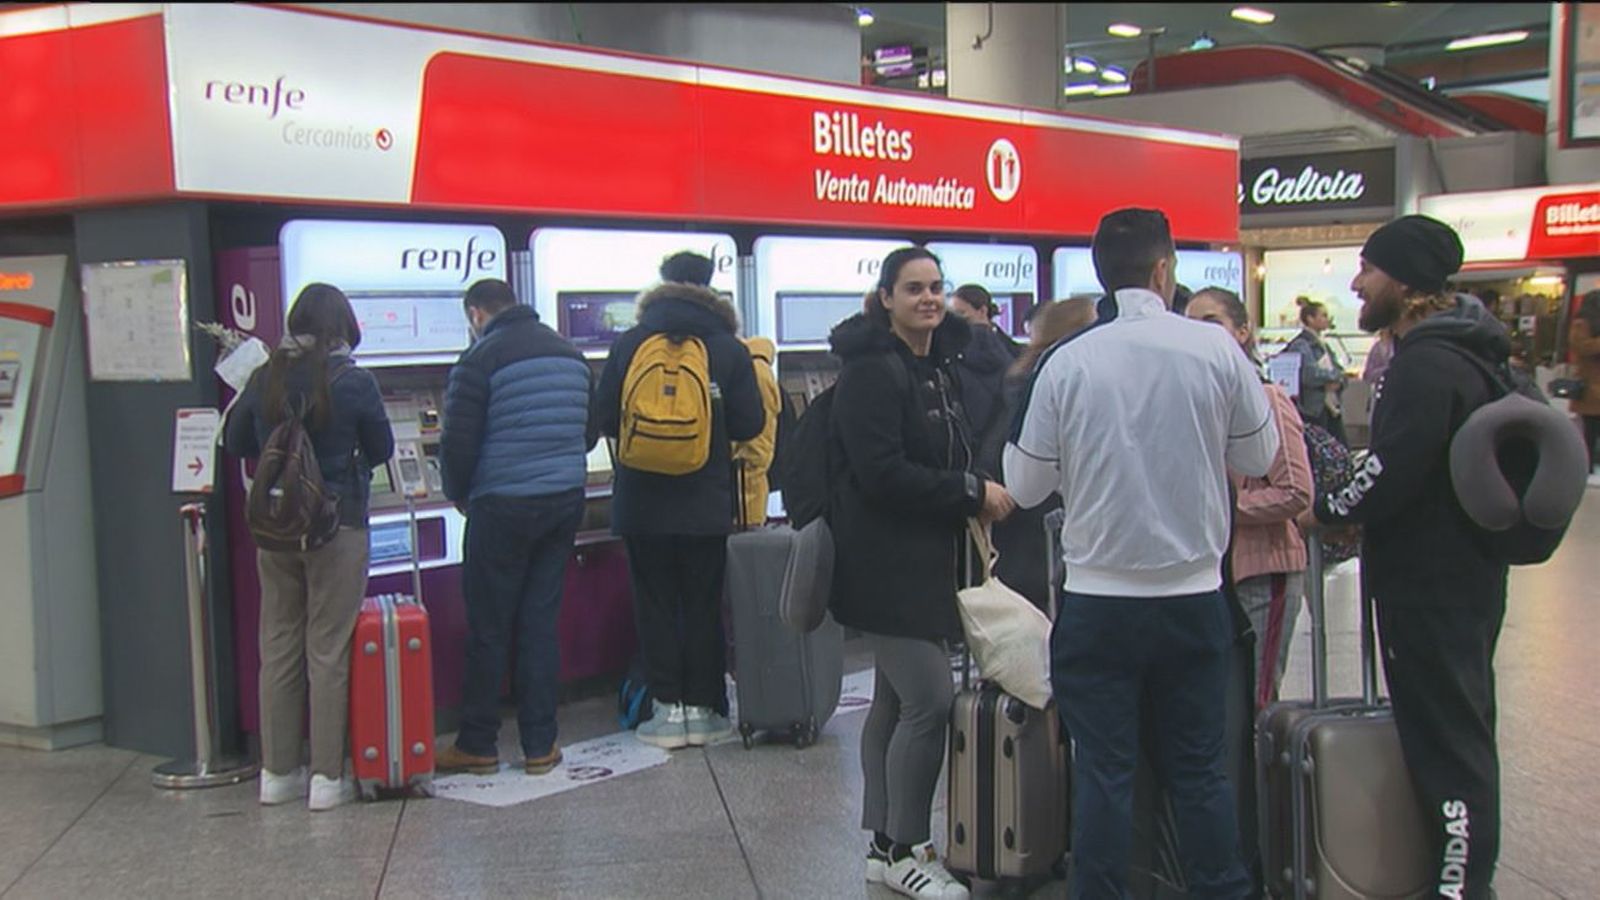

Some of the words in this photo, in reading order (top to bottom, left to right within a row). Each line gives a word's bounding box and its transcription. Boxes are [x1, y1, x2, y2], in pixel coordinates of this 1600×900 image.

[205, 75, 305, 120] renfe
[282, 120, 373, 151] Cercanías
[813, 111, 913, 161] Billetes
[814, 168, 870, 203] Venta
[872, 173, 976, 209] Automática
[1252, 165, 1365, 204] Galicia
[401, 235, 497, 283] renfe
[984, 254, 1034, 287] renfe
[1204, 258, 1241, 287] renfe
[1439, 799, 1470, 900] ADIDAS
